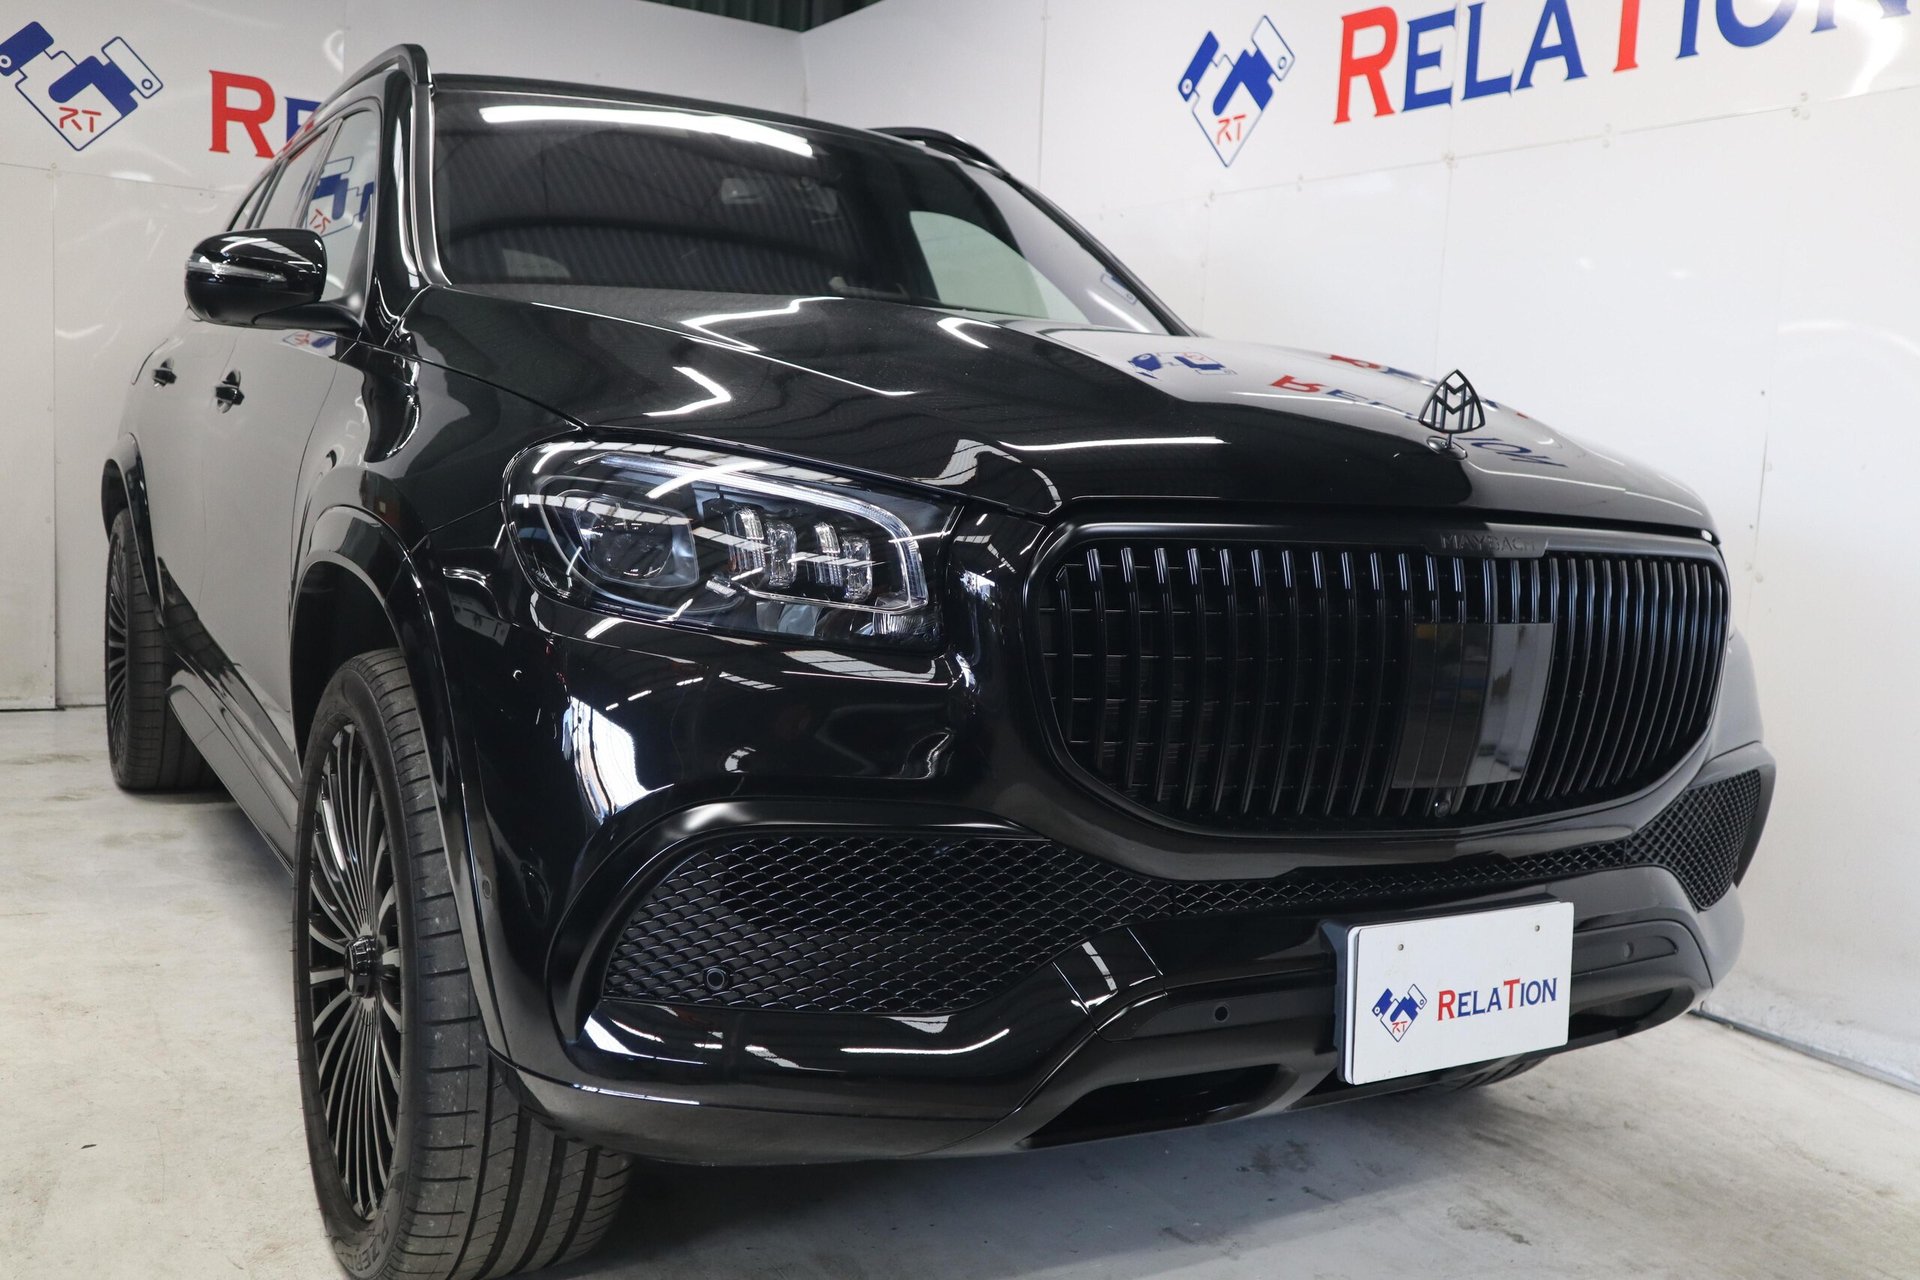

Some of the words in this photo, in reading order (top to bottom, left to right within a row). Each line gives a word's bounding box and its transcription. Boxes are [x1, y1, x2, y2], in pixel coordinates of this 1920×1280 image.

[59, 106, 102, 133] RT
[1216, 114, 1246, 146] RT
[1437, 977, 1558, 1021] RELATION
